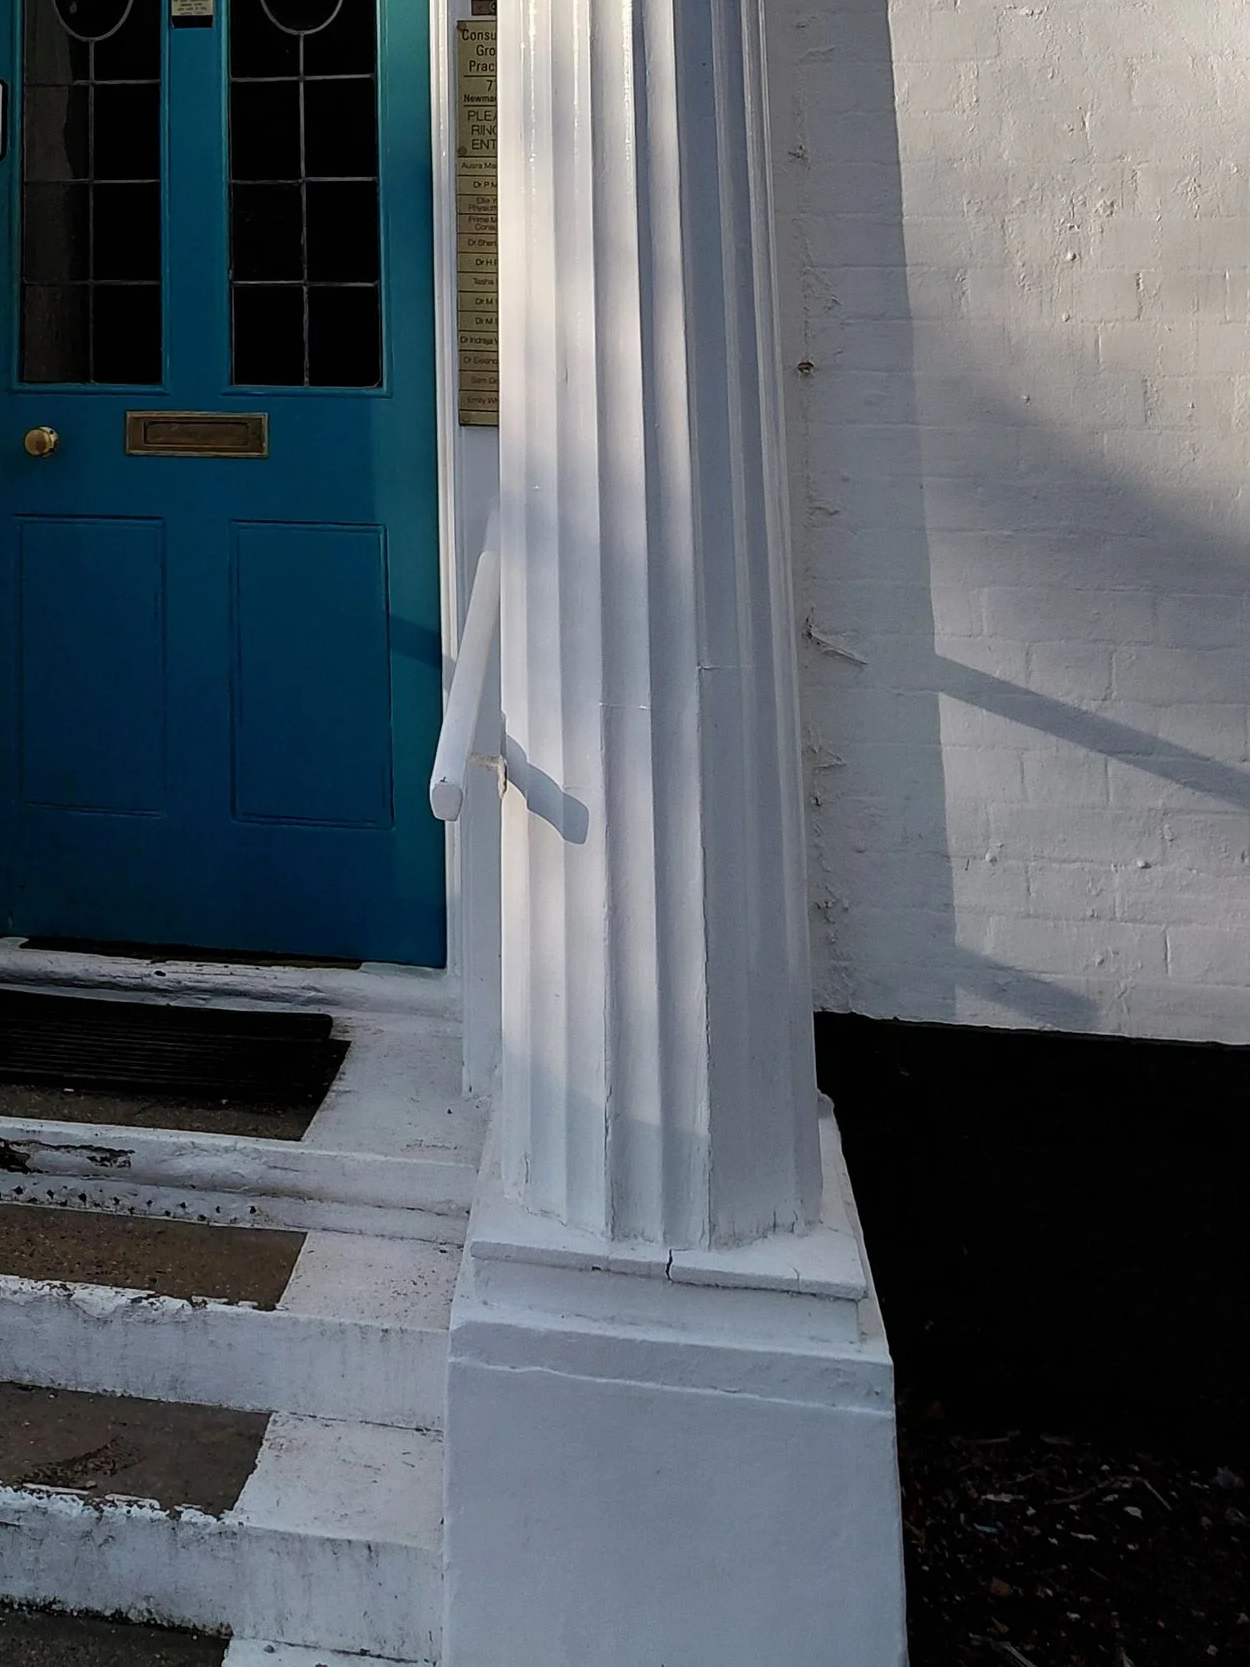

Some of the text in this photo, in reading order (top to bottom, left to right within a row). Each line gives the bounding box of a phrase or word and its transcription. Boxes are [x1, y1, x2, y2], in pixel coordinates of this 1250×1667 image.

[461, 29, 497, 41] Consu
[476, 44, 496, 57] Gro
[469, 60, 496, 72] Prac
[486, 79, 497, 92] 7
[471, 138, 497, 150] ENT
[475, 258, 484, 266] Dr
[475, 297, 484, 305] Dr
